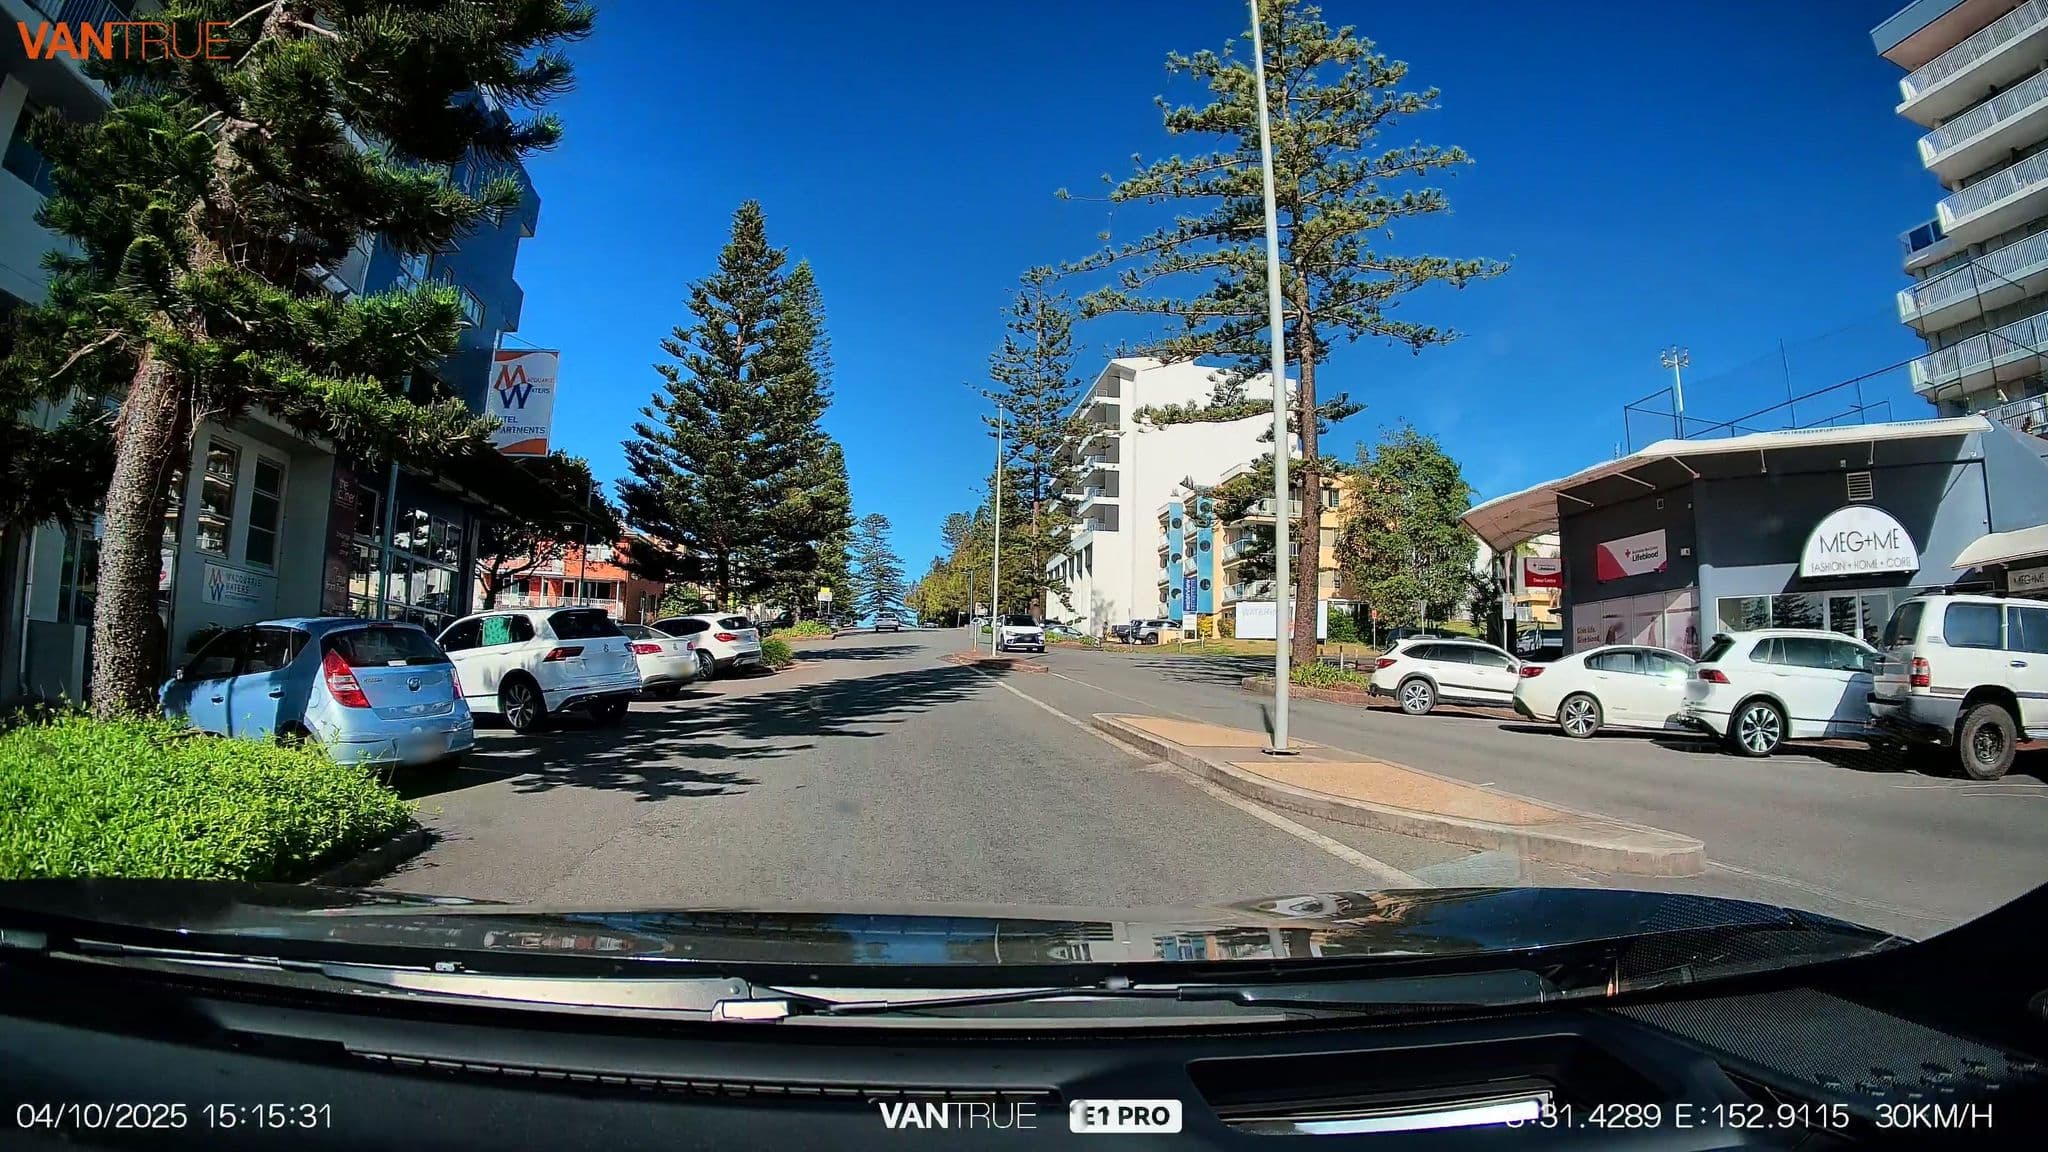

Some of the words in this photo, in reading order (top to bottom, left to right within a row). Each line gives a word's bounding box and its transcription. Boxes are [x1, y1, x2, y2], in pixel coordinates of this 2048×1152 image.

[1819, 528, 1900, 554] MEG+ME
[1632, 550, 1659, 562] Lifeblood
[1811, 560, 1846, 573] FASHION
[1854, 558, 1878, 570] HOME
